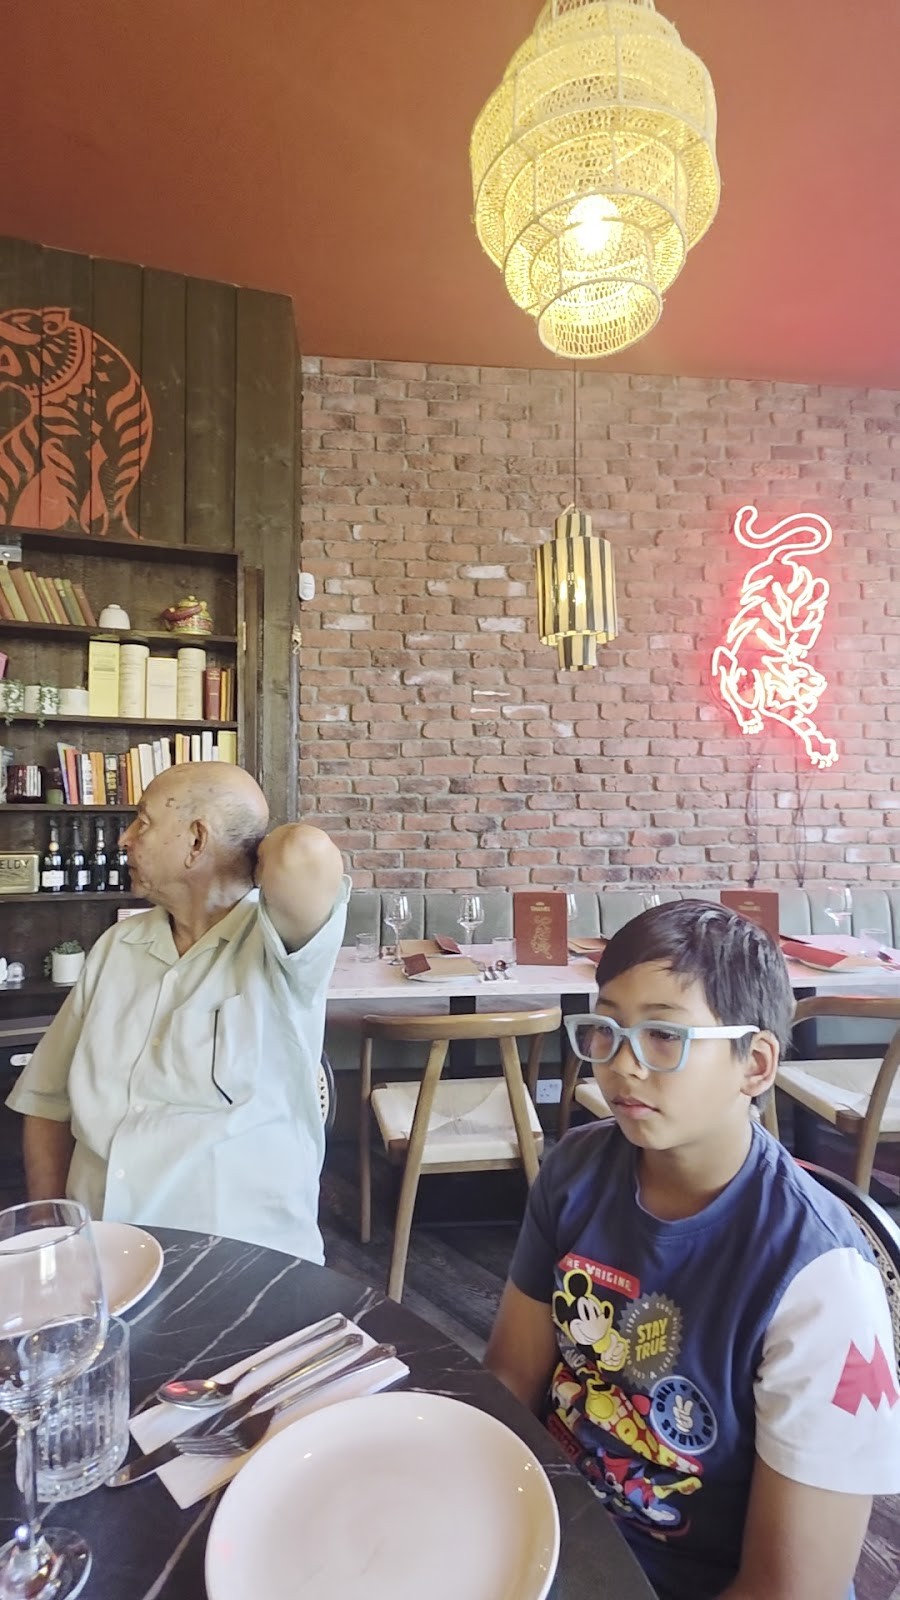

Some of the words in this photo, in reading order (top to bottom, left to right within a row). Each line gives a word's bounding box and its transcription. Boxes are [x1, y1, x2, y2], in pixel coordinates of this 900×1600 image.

[637, 1317, 668, 1344] STAY
[635, 1334, 668, 1362] TRUE
[656, 1382, 676, 1413] ONLY
[661, 1419, 704, 1446] VIBES
